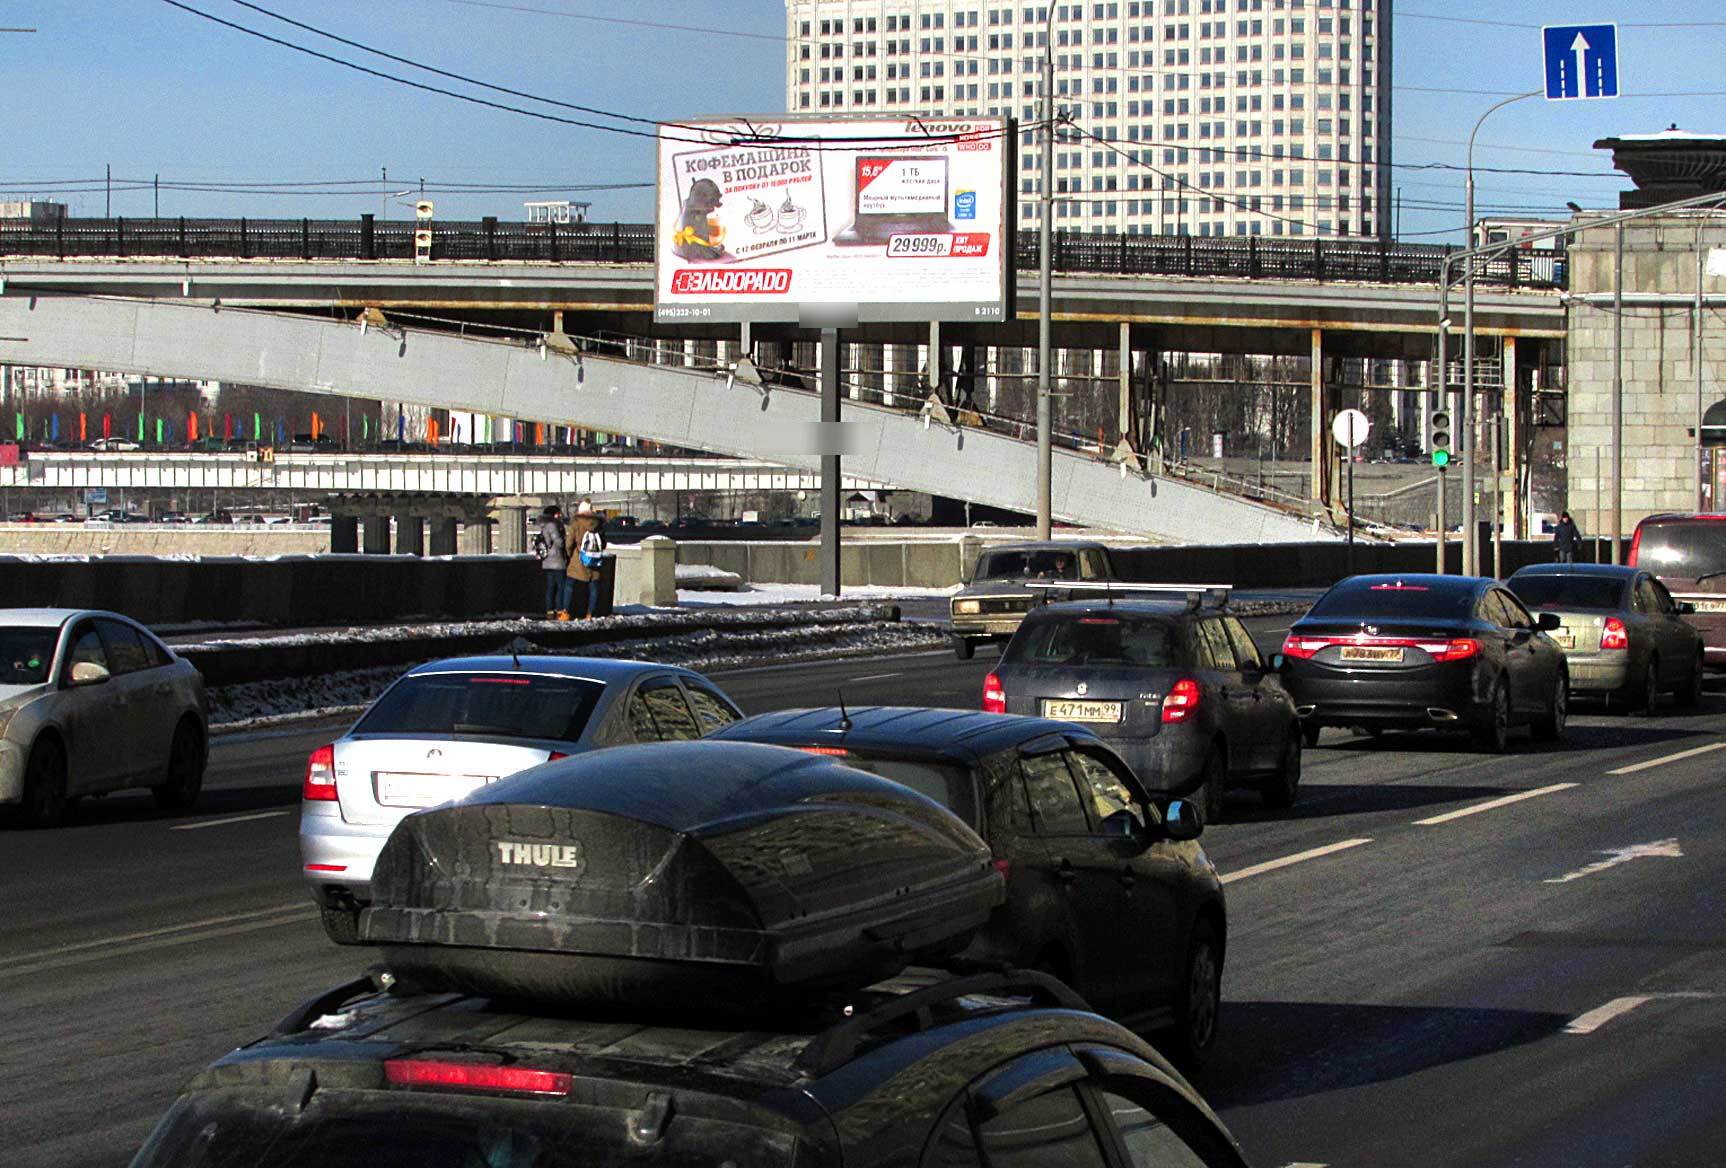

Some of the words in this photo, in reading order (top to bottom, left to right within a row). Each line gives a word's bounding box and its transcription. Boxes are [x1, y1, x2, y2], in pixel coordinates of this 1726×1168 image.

[685, 145, 811, 173] КОФЕМАШИНА
[723, 171, 733, 183] В
[736, 159, 812, 182] ПОДАРОК
[910, 168, 920, 176] ТБ
[751, 239, 778, 251] ФЕВРАЛЯ
[797, 232, 817, 241] МАРТА
[689, 271, 788, 292] ЭЛЬДОРАДО
[498, 842, 577, 868] THULE
